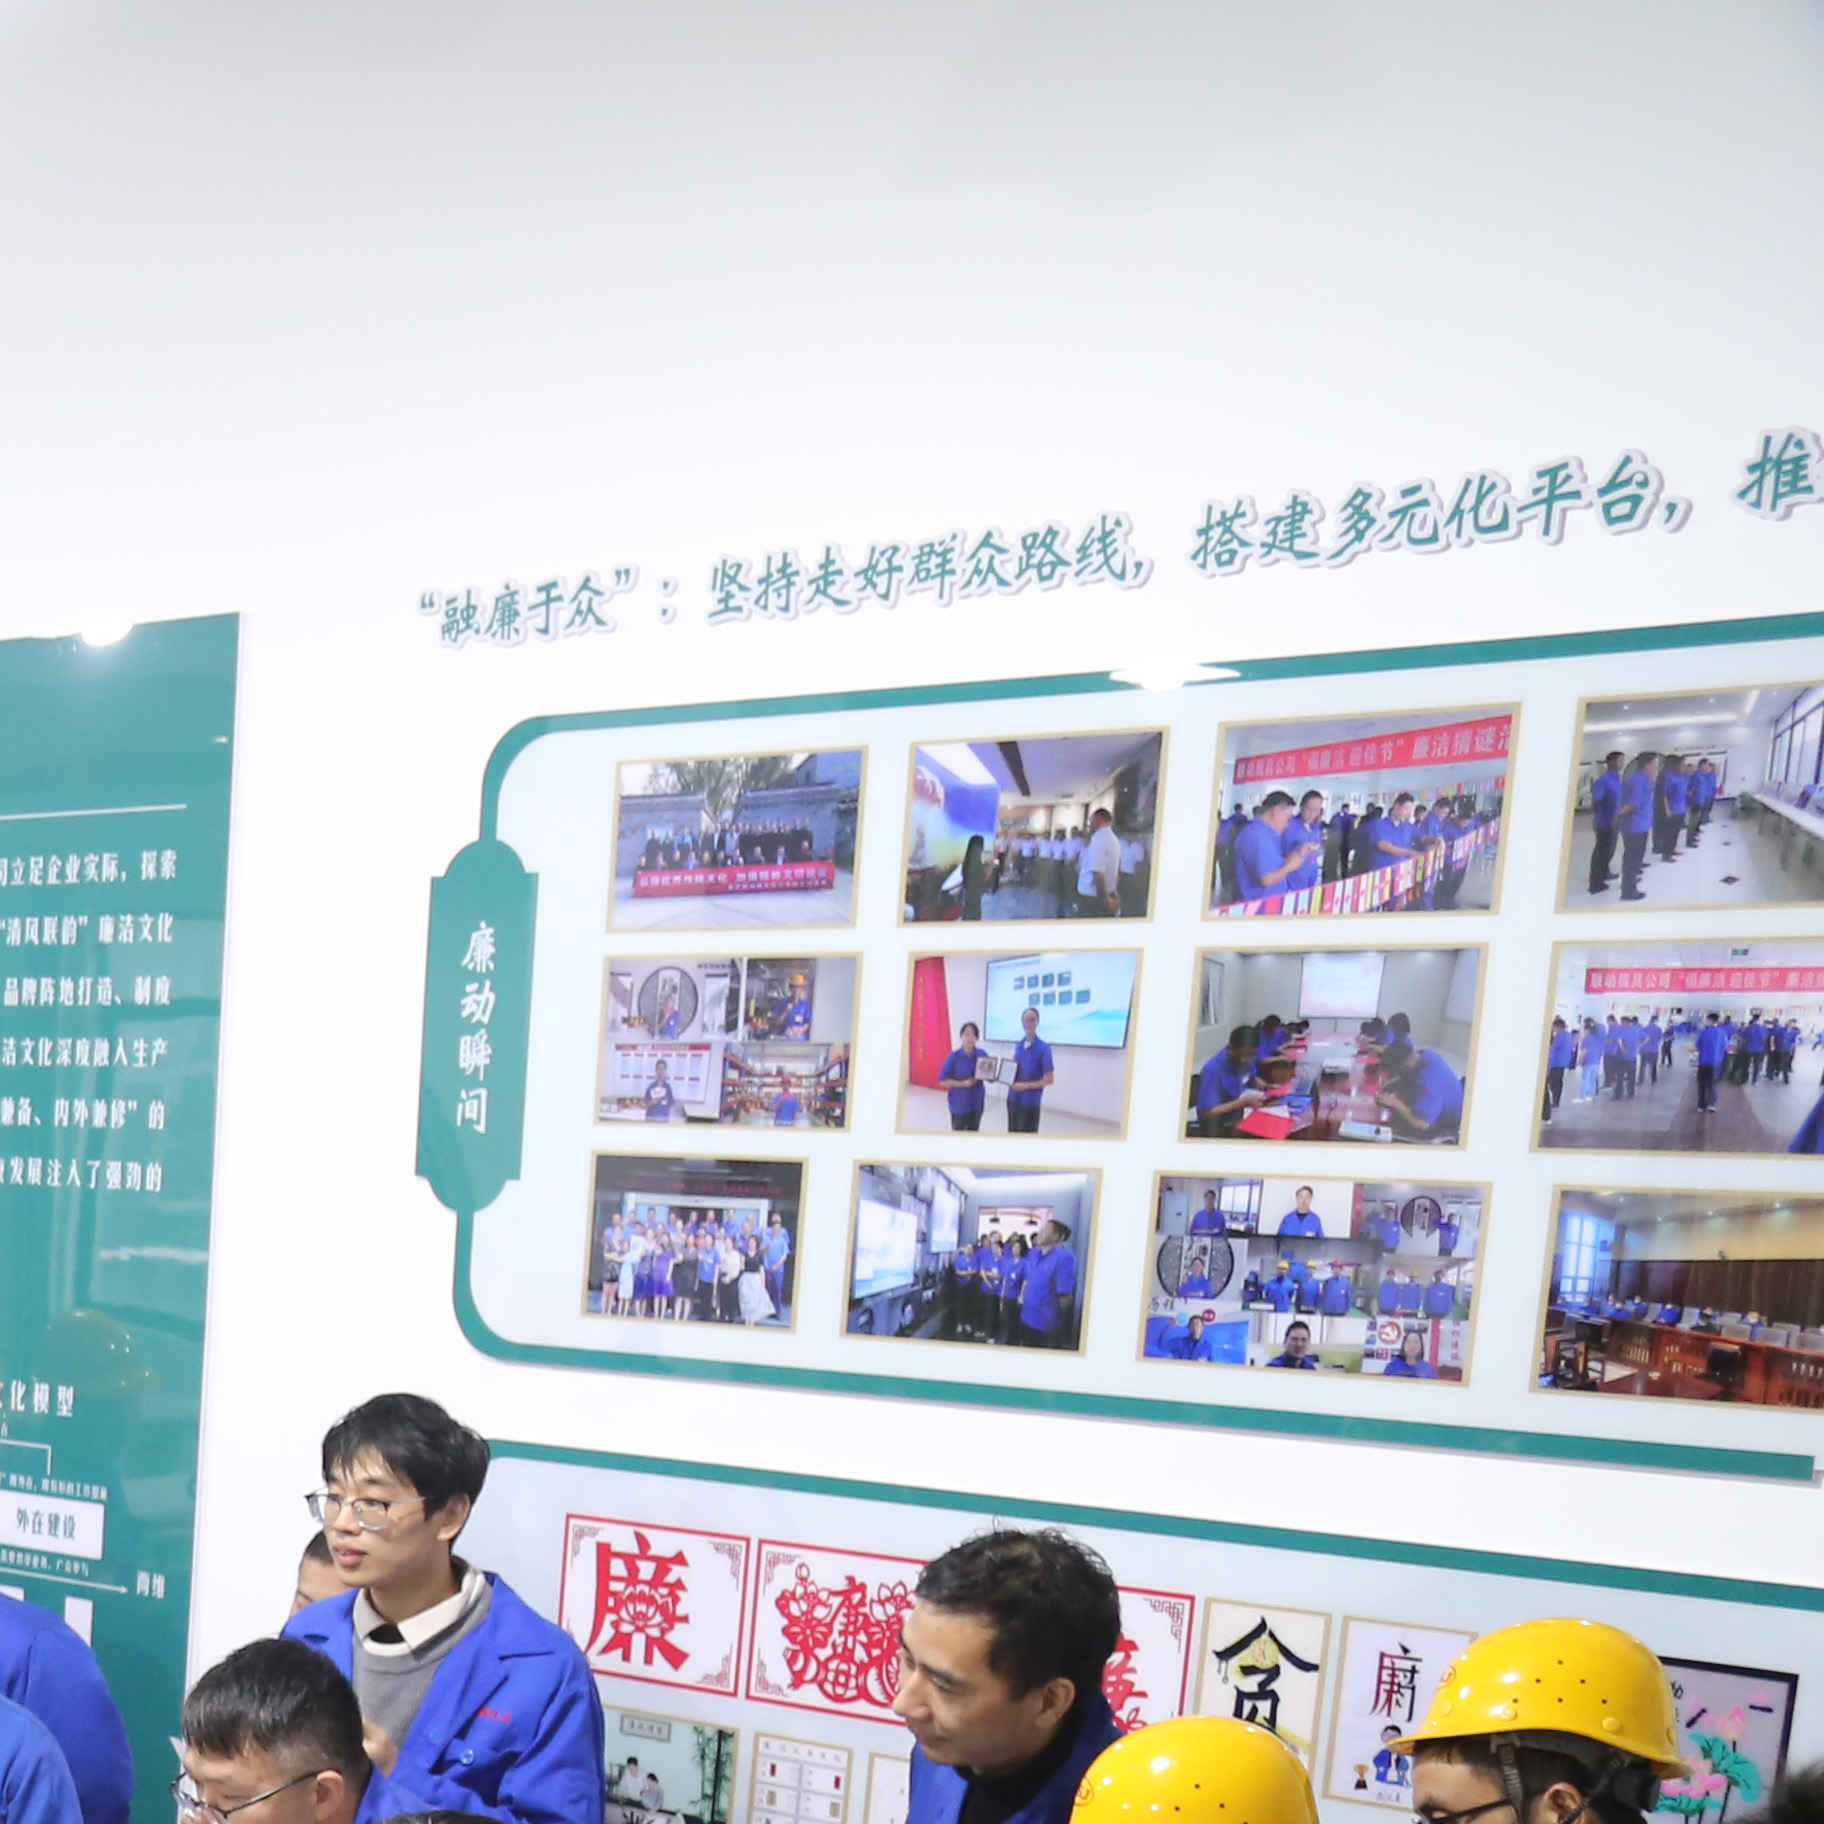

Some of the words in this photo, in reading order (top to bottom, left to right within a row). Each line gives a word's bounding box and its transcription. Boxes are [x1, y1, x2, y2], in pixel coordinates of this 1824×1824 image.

[456, 921, 497, 1135] 廉动瞬间
[16, 1507, 76, 1540] 外在建设
[136, 1569, 166, 1599] 两维
[1212, 1615, 1319, 1732] 贪
